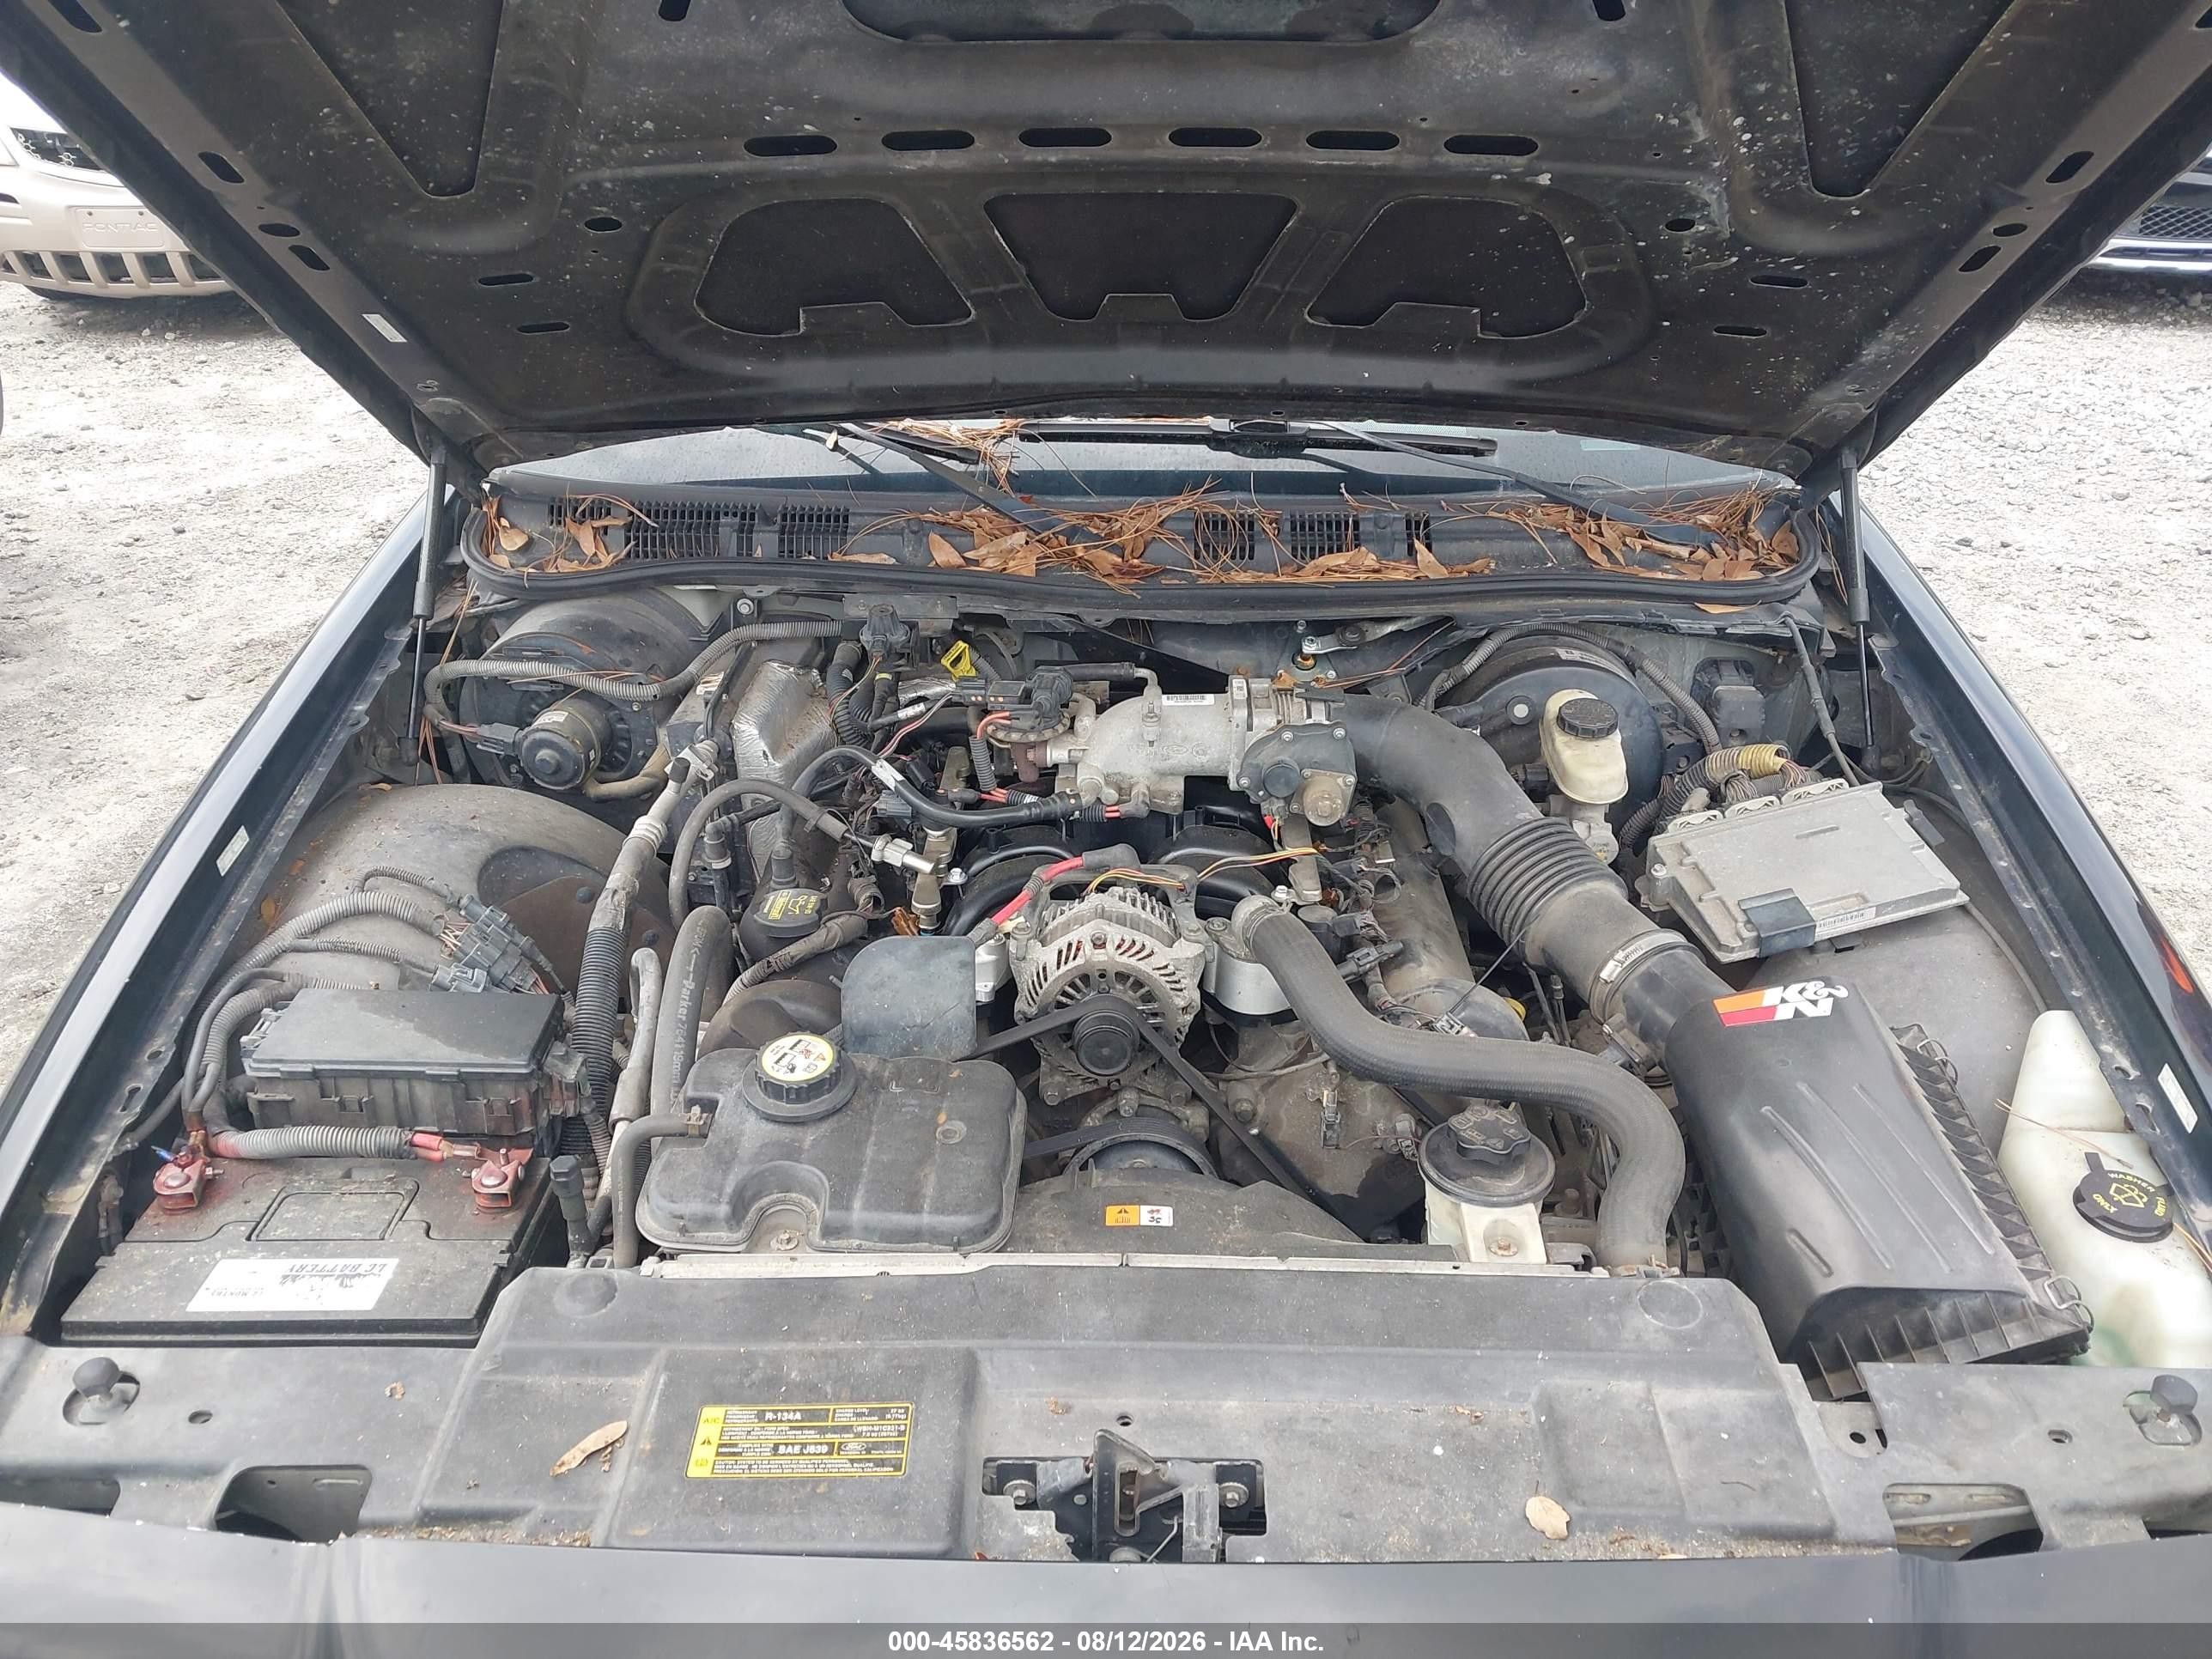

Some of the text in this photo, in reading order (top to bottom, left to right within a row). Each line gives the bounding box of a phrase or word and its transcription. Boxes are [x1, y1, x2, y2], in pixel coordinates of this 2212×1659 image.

[83, 222, 159, 233] PONTIAC
[678, 979, 696, 1021] Parker
[1760, 980, 1850, 1021] K&N
[2107, 1172, 2156, 1193] WASHER
[2092, 1193, 2119, 1213] ONLY
[2154, 1196, 2168, 1217] FLUID
[287, 1263, 361, 1273] BATTERY
[764, 1411, 802, 1421] R-134A
